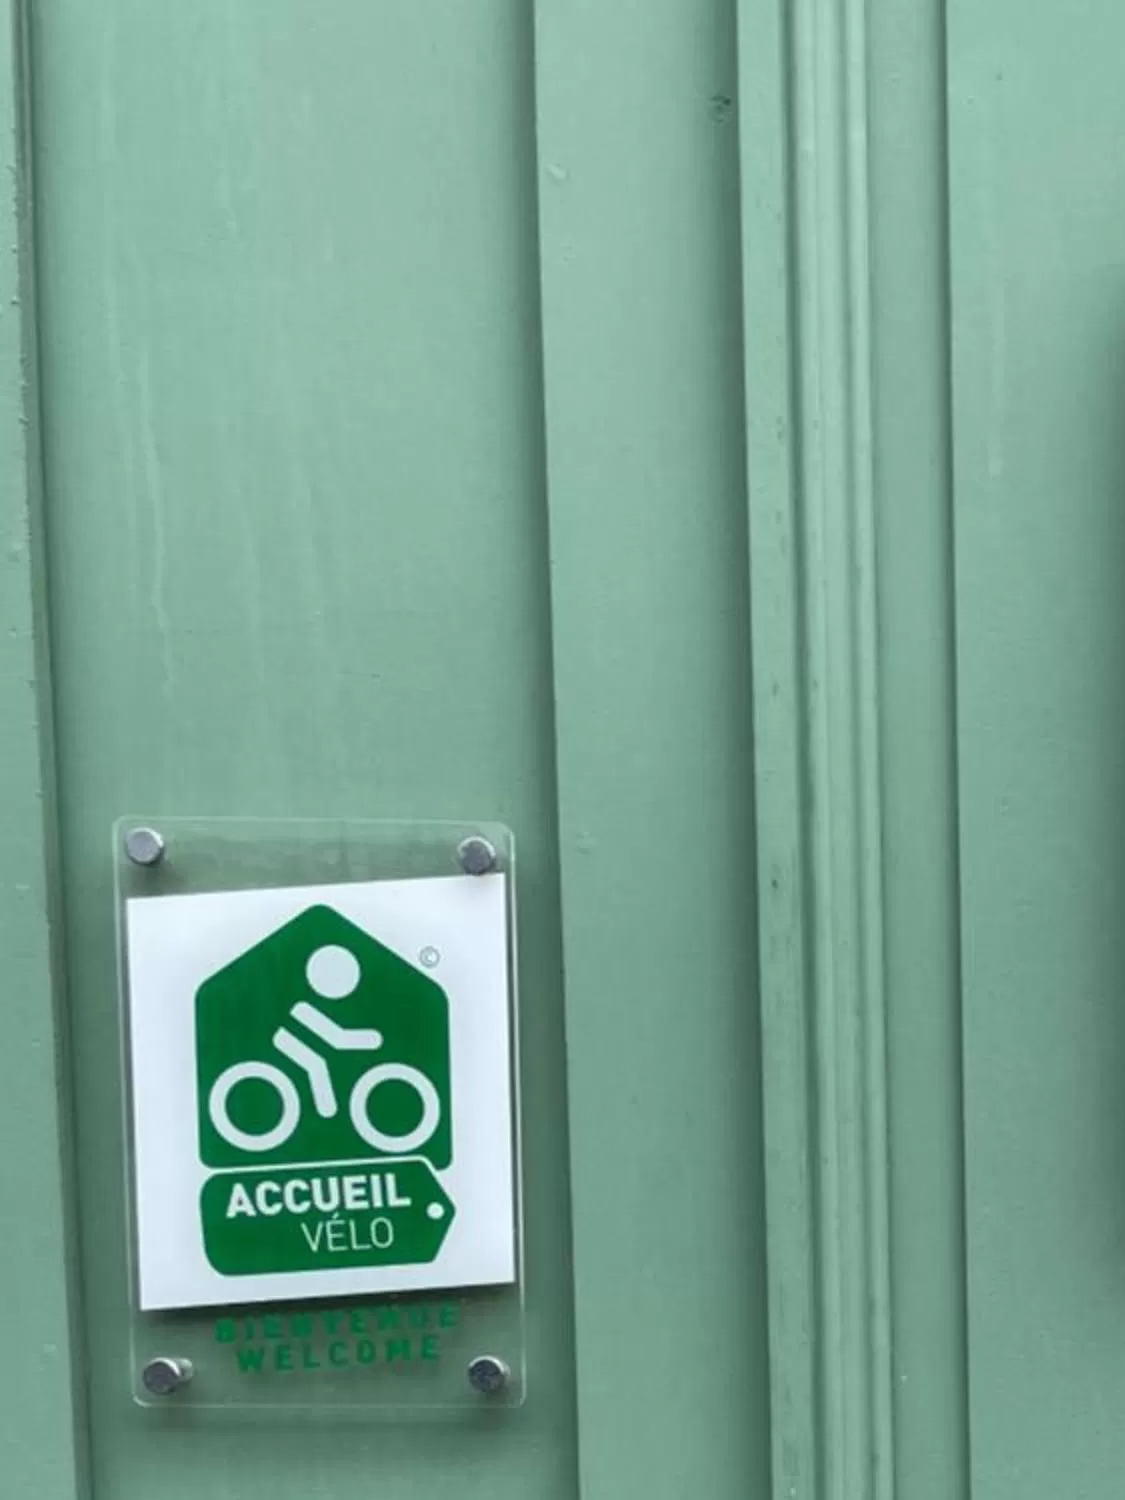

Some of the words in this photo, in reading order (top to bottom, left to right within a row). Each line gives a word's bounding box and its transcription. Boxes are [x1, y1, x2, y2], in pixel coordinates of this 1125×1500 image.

[226, 1173, 412, 1218] ACCUEIL
[301, 1212, 394, 1252] VÉLO
[238, 1334, 441, 1373] WELCOME
